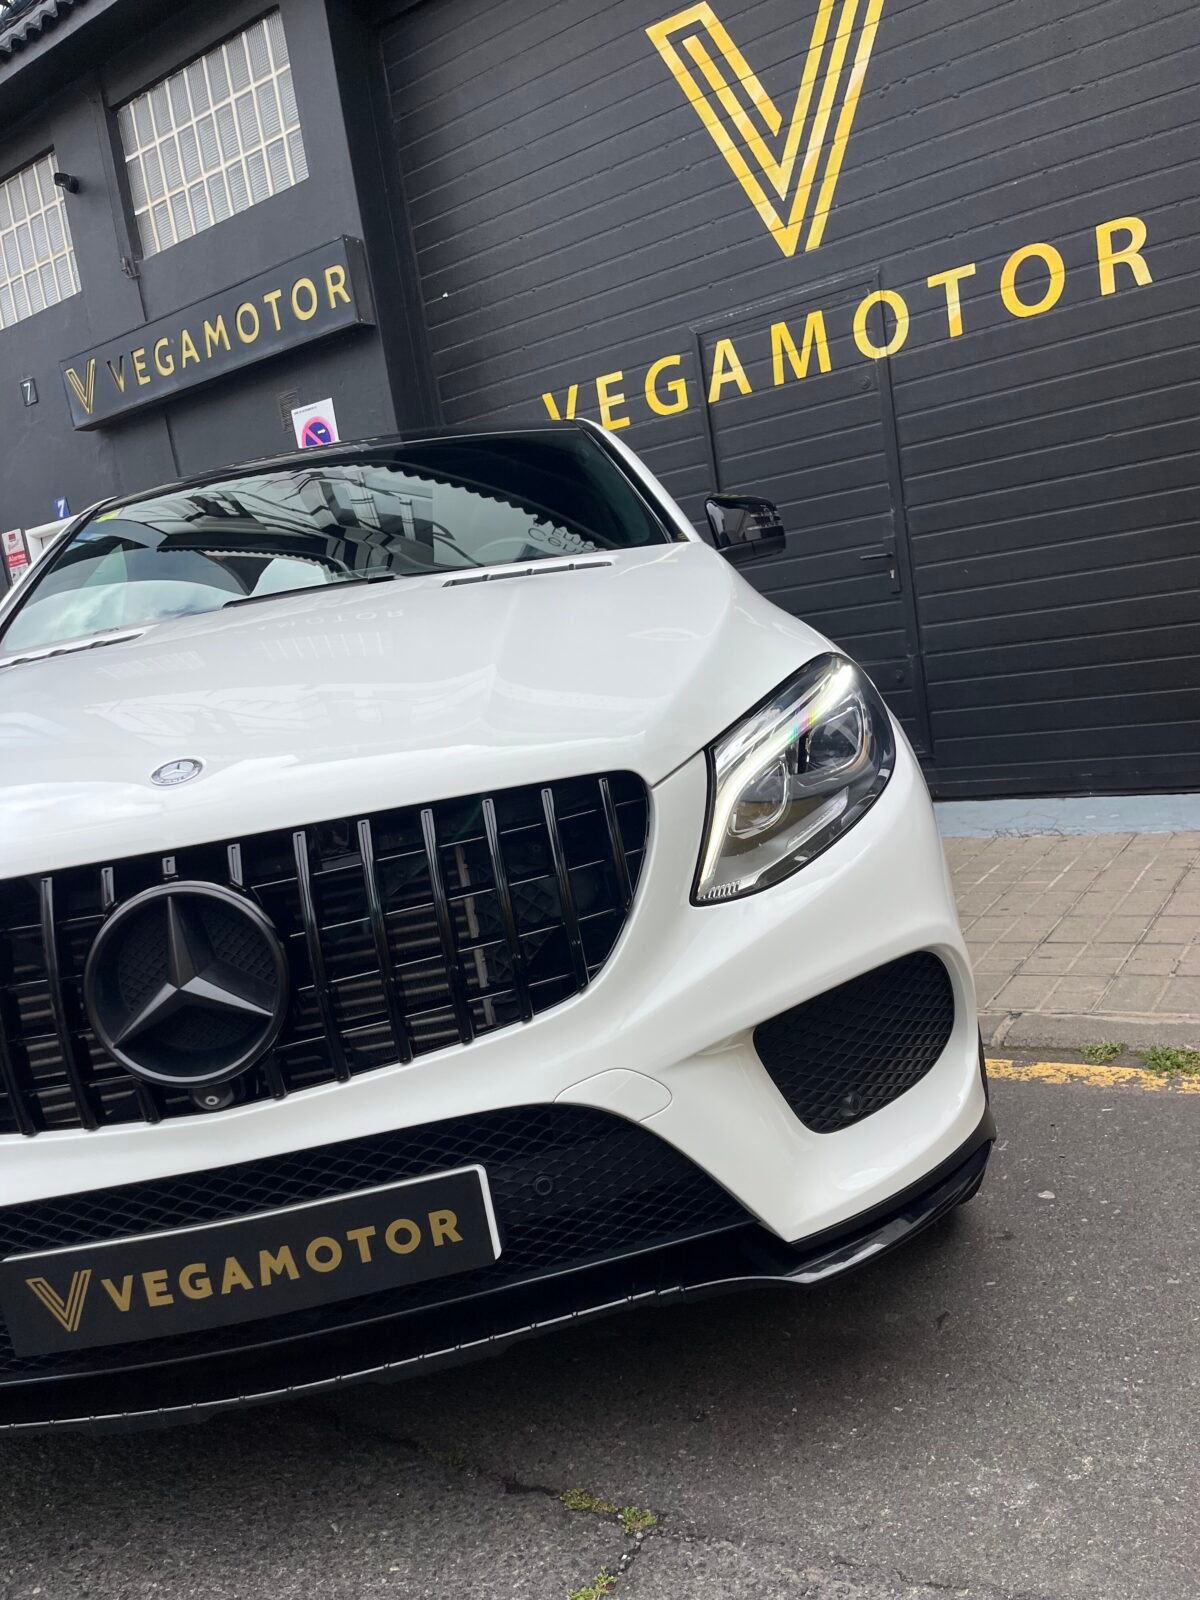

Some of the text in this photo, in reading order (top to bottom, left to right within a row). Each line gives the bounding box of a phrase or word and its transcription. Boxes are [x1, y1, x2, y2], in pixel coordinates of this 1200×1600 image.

[106, 264, 352, 393] VEGAMOTOR
[542, 216, 1153, 432] VEGAMOTOR
[23, 382, 32, 402] 7
[56, 499, 66, 518] 7
[101, 1209, 463, 1313] VEGAMOTOR
